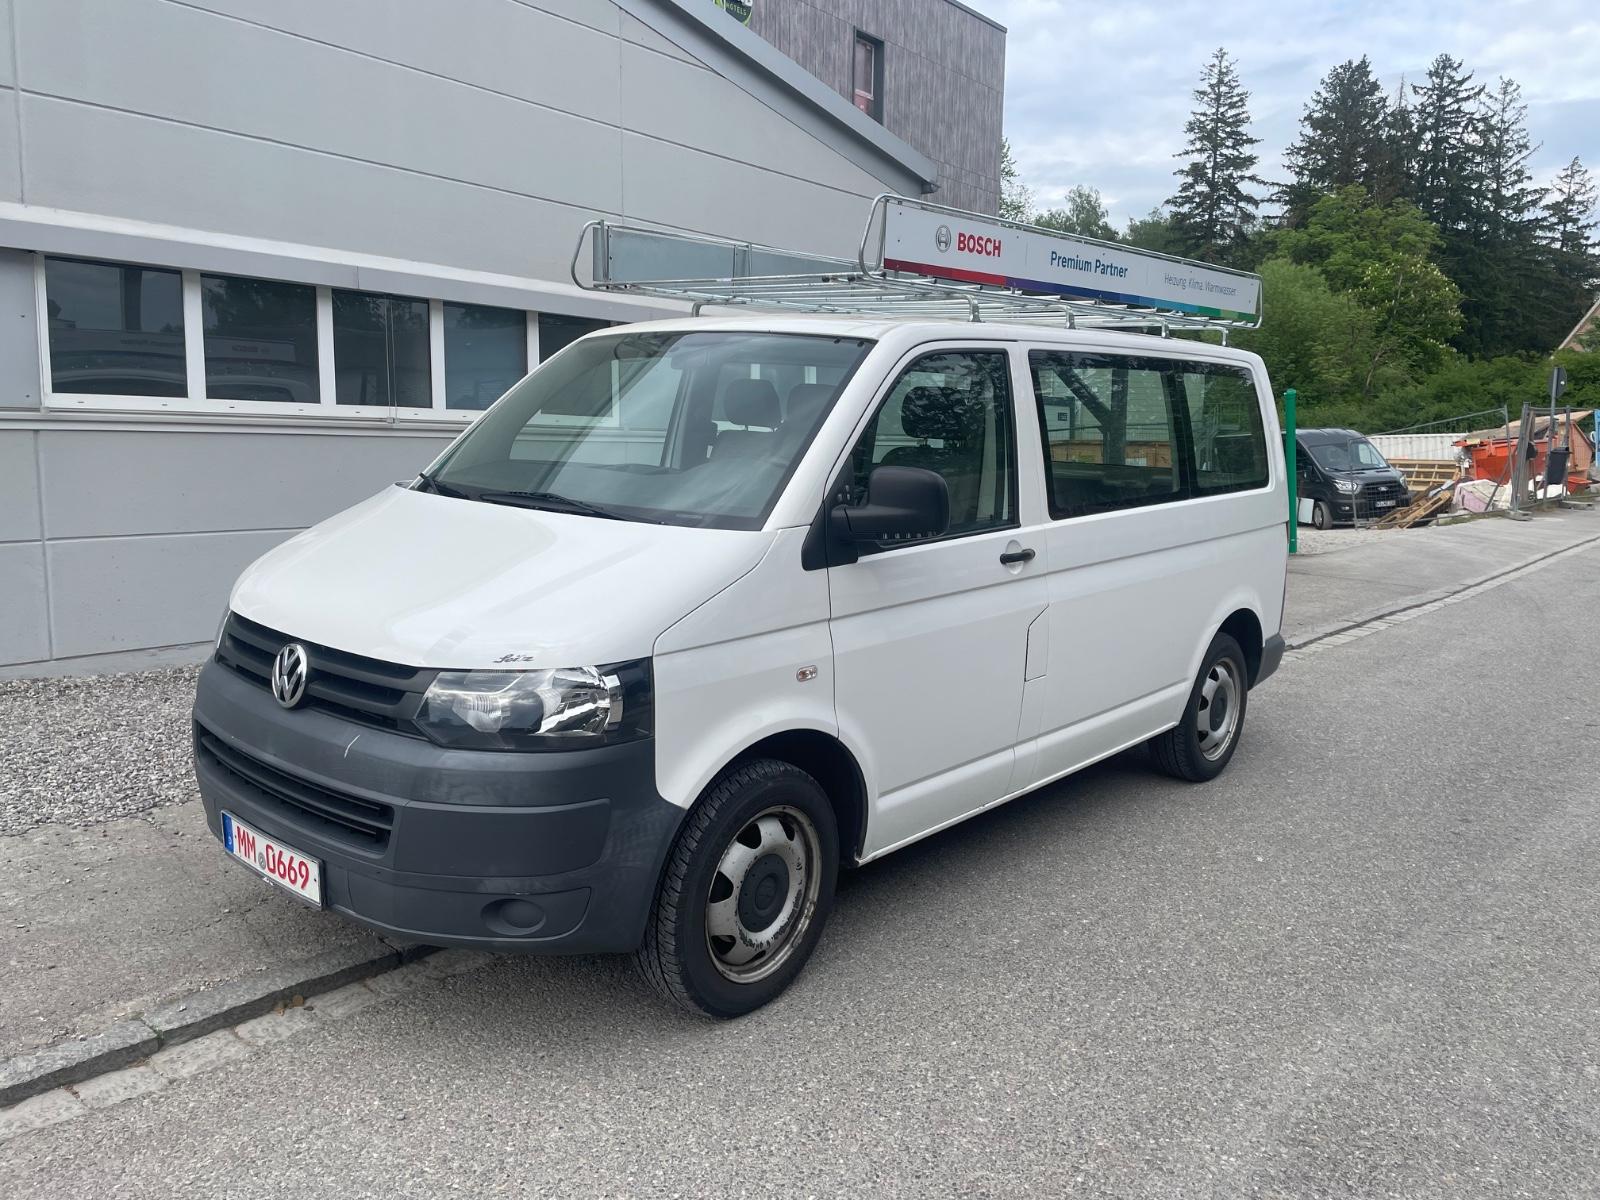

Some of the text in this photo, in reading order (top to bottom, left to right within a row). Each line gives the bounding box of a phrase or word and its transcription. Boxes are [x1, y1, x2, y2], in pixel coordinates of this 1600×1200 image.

[957, 232, 1002, 257] BOSCH
[1050, 251, 1129, 278] Premium Partner
[272, 643, 307, 708] VW
[236, 825, 310, 890] MM 0669
